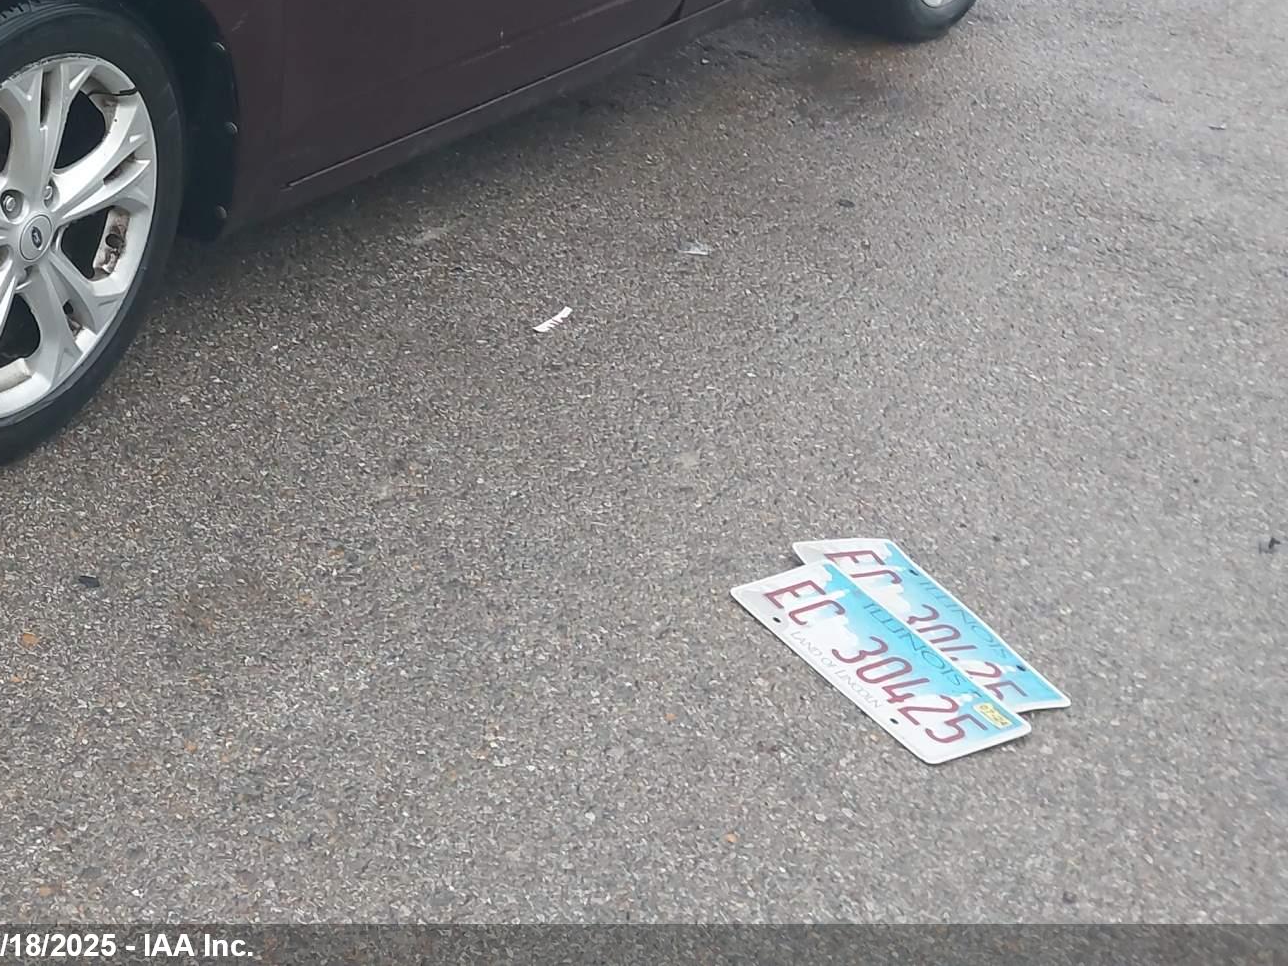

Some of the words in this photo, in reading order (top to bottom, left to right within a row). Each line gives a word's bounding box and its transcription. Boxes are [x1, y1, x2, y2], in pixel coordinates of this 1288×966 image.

[763, 580, 846, 626] EC
[831, 635, 988, 744] 30425
[863, 602, 964, 687] ILLINOIS
